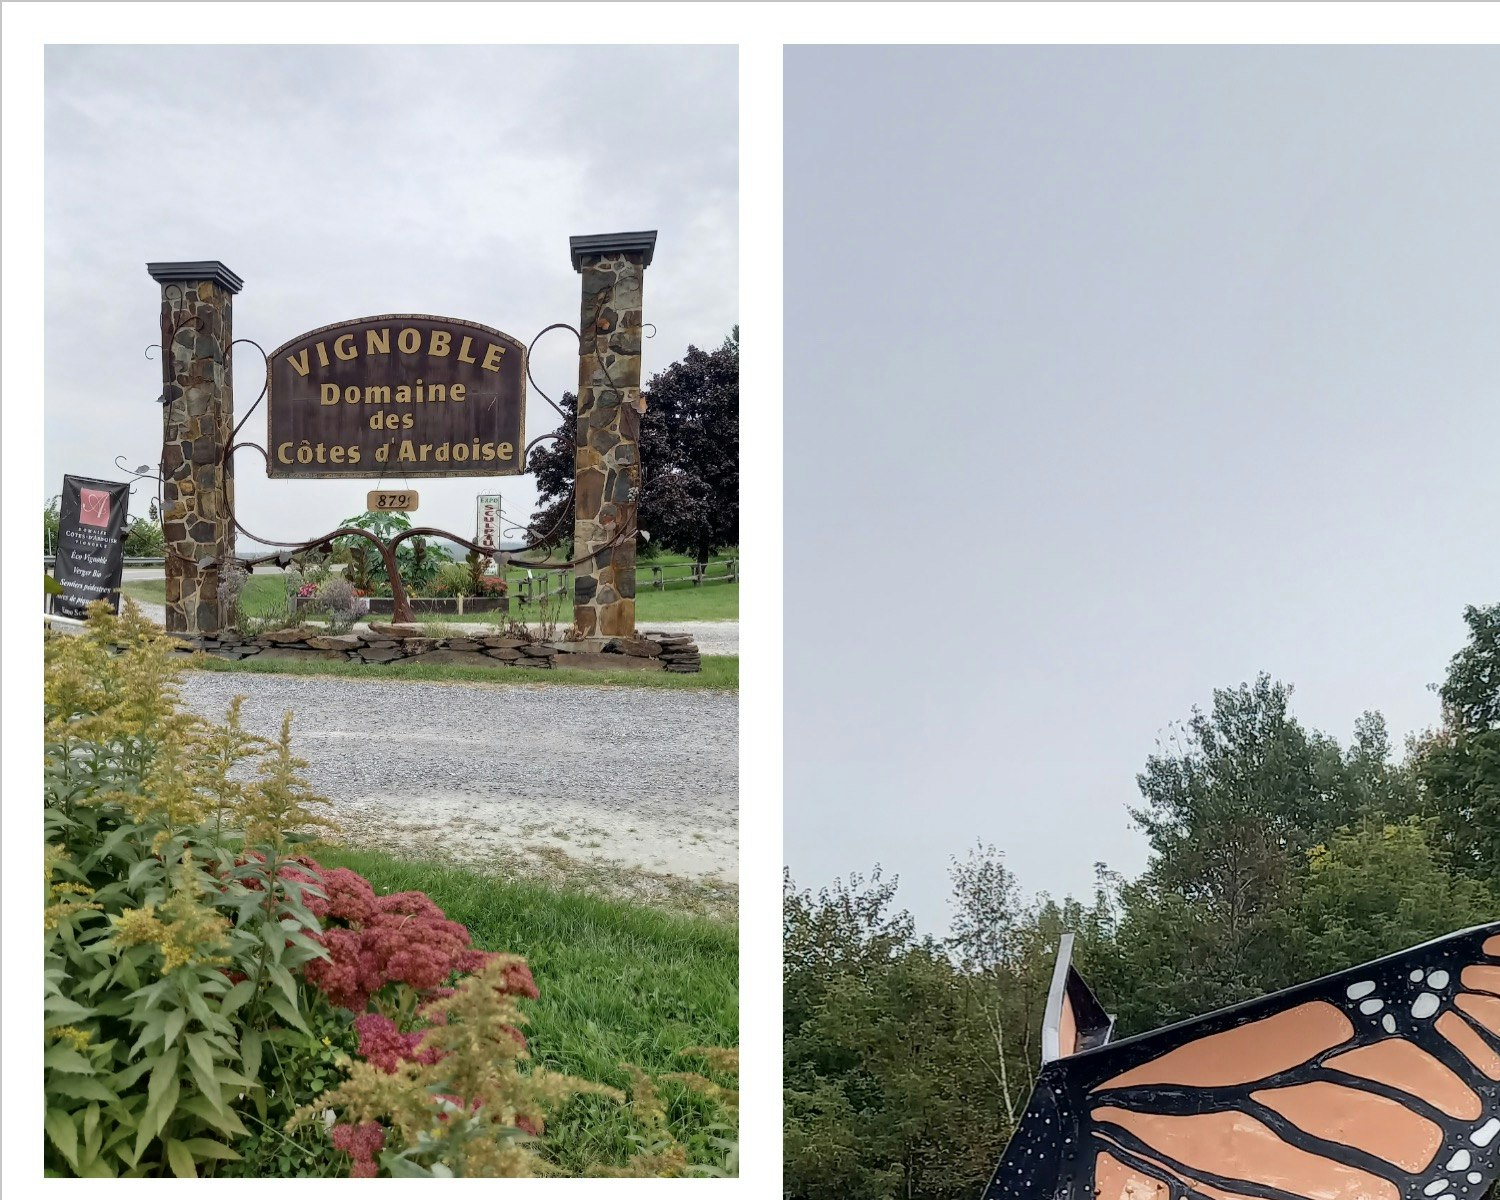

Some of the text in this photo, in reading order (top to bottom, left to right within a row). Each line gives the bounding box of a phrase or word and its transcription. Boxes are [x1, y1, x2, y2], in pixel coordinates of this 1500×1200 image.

[287, 328, 506, 377] VIGNOBLE
[320, 379, 466, 406] Domaine
[369, 410, 414, 430] des
[277, 436, 513, 464] Côtes d'Ardoise
[378, 494, 406, 507] 879
[75, 539, 108, 549] VIGNOBLE
[83, 553, 108, 565] Vignoble
[73, 566, 102, 578] Verger Bio
[60, 578, 111, 593] Sentiers pédestres
